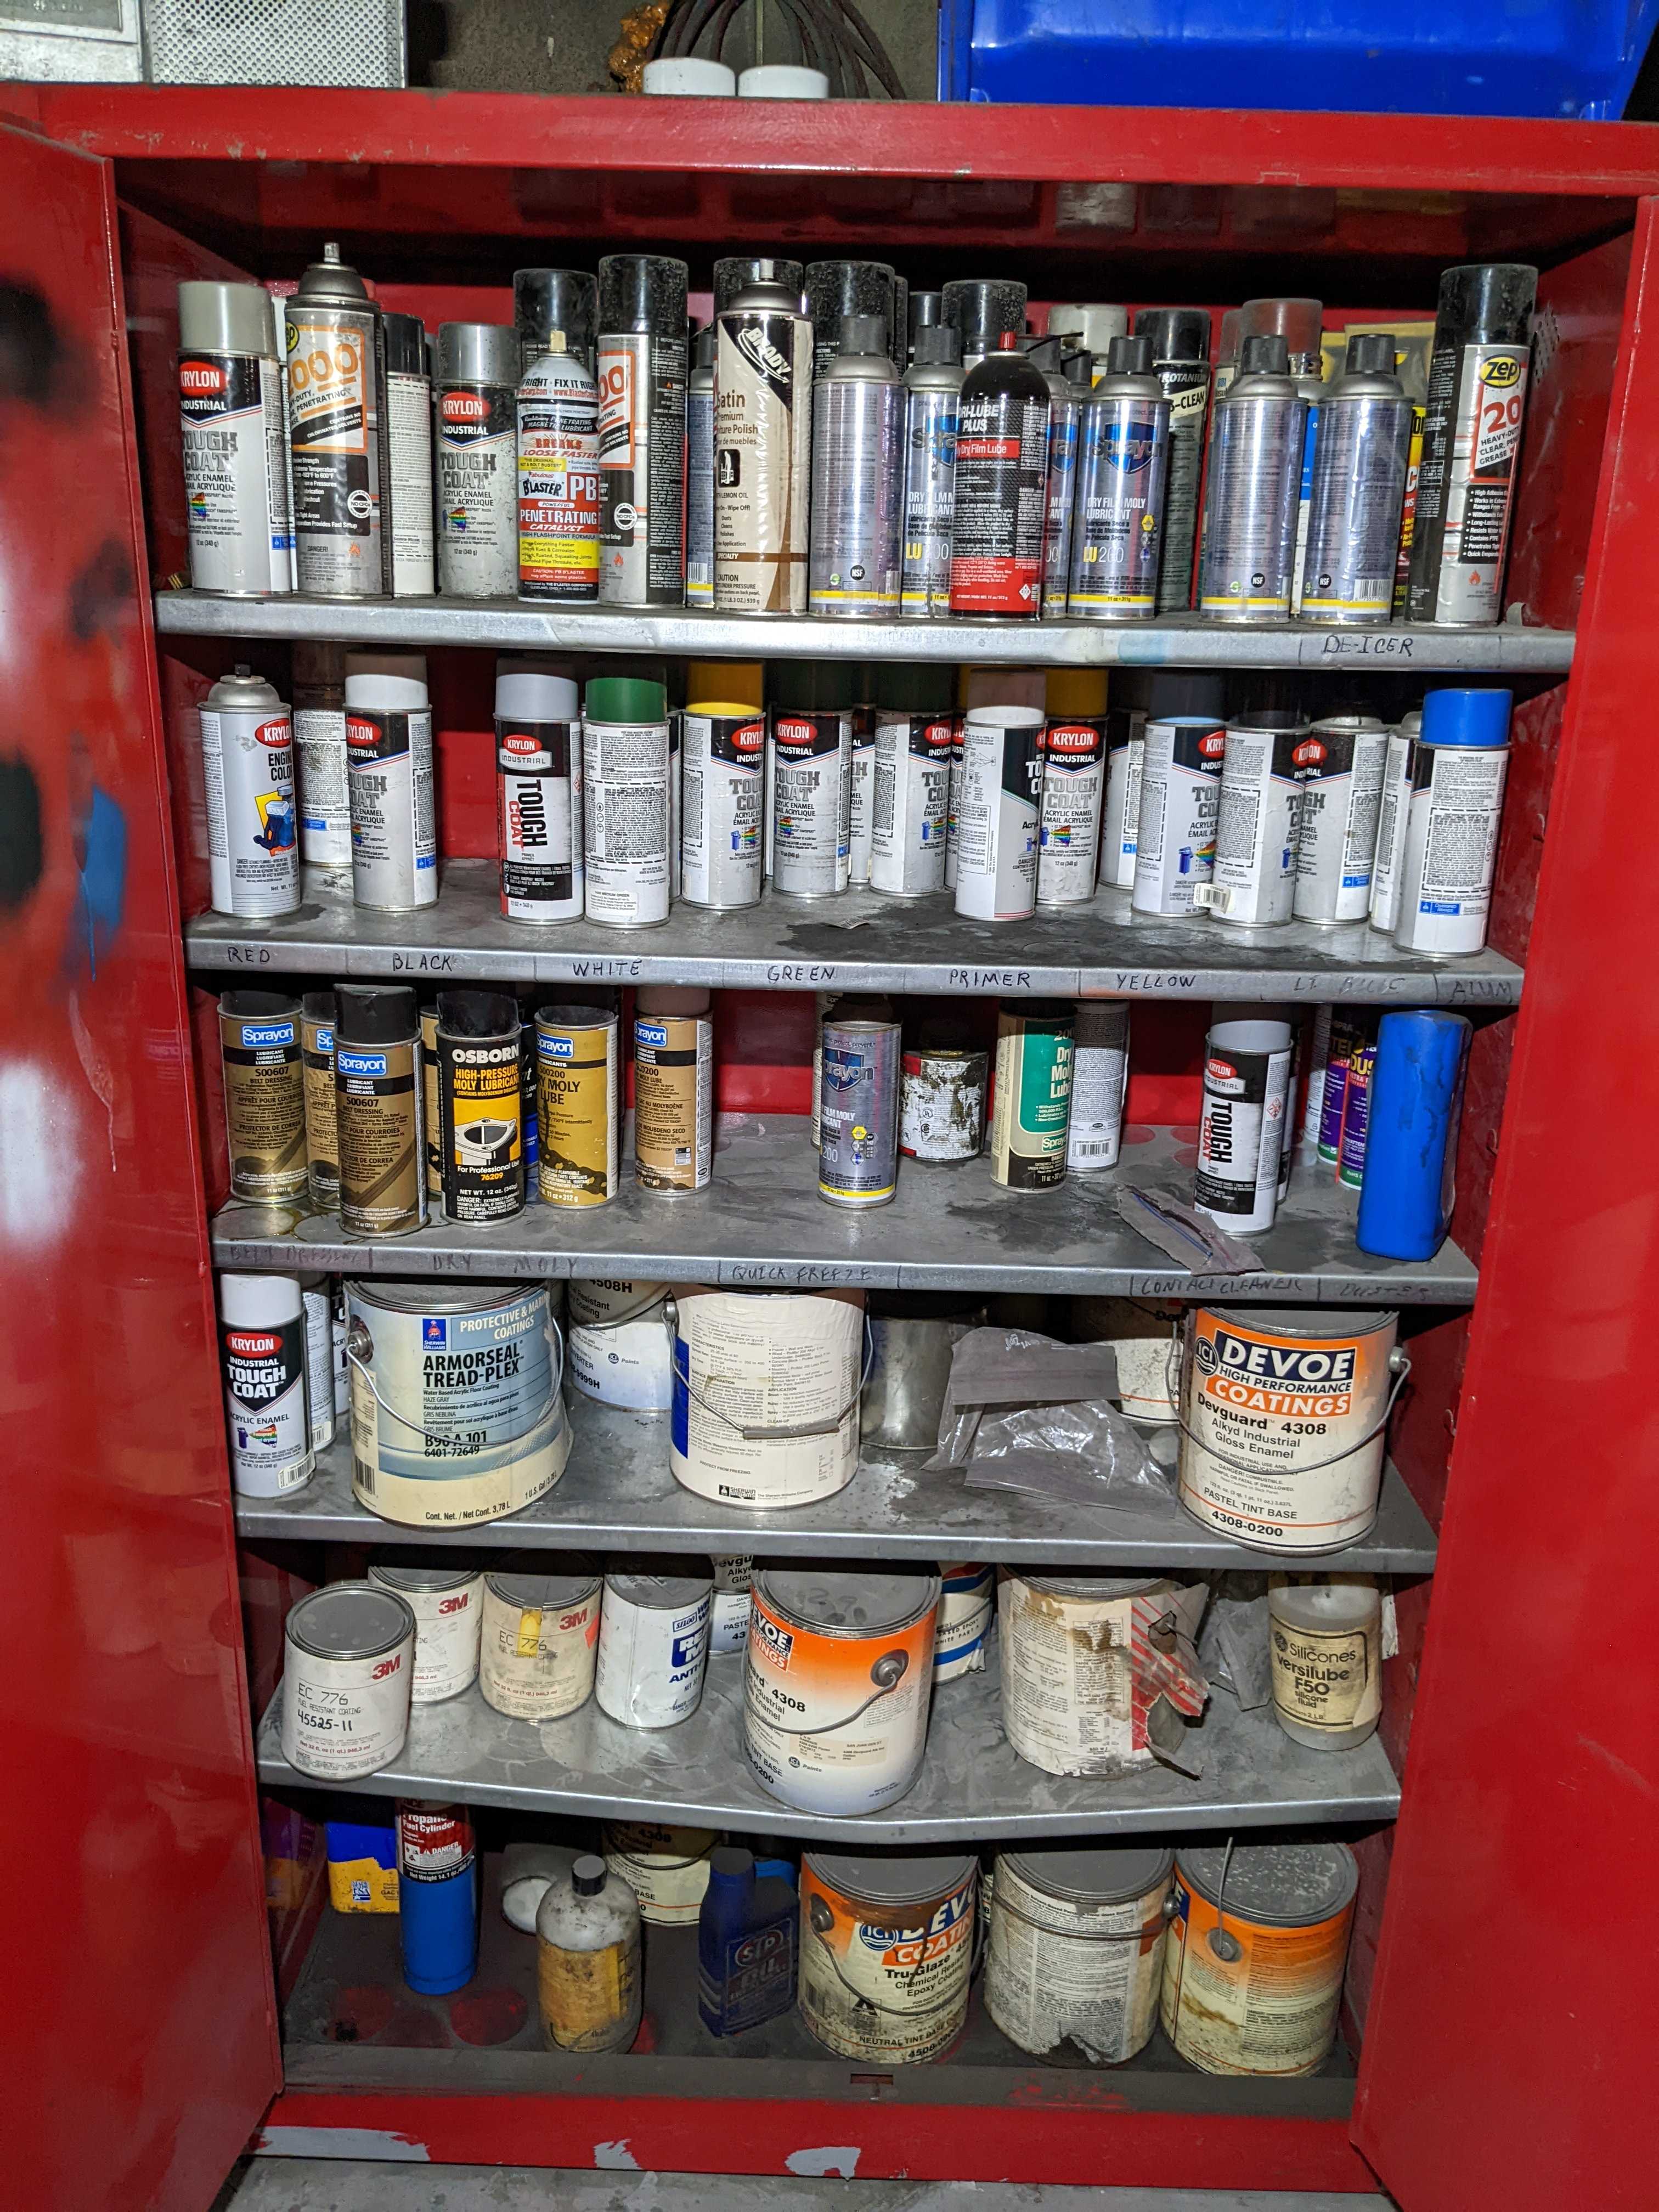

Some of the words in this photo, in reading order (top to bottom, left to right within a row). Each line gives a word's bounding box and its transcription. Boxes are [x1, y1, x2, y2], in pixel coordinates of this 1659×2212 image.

[555, 379, 571, 387] FIX
[443, 400, 483, 415] KRYLON
[733, 424, 758, 434] Polish
[963, 419, 988, 432] PLUS
[535, 438, 582, 450] BREAKS
[971, 444, 986, 454] Film
[988, 444, 1007, 454] Lube
[561, 450, 597, 459] FASTER
[203, 474, 233, 482] ENAMEL
[443, 471, 489, 489] COAT
[570, 475, 597, 501] PB
[908, 492, 924, 503] DRY
[1087, 497, 1102, 508] DRY
[1125, 498, 1146, 509] MOLY
[520, 509, 597, 524] PENETRATING
[1322, 633, 1415, 658] DE-ICER
[777, 723, 810, 739] KRYLON
[1053, 732, 1093, 746] KRYLON
[507, 739, 535, 751] KRYLON
[502, 754, 546, 764] INDUSTRIAL
[1049, 754, 1096, 763] INDUSTRIAL
[1043, 776, 1098, 793] TOUGH
[1047, 793, 1091, 809] COAT
[517, 779, 548, 848] TOUGH
[785, 808, 816, 817] ACRYLIQUE
[509, 800, 524, 849] COAT
[228, 946, 270, 964] RED
[393, 952, 453, 972] BLACK
[573, 960, 642, 977] WHITE
[767, 966, 835, 982] GREEN
[949, 968, 1030, 988] PRIMER
[1116, 974, 1197, 989] YELLOW
[244, 1026, 292, 1043] Sprayon
[452, 1044, 520, 1064] OSBORN
[338, 1054, 386, 1071] Sprayon
[1209, 1062, 1231, 1076] KRYLON
[255, 1066, 289, 1077] S00607
[265, 1075, 293, 1084] DRESSING
[455, 1063, 518, 1080] HIGH-PRESSURE
[454, 1079, 476, 1091] MOLY
[548, 1079, 581, 1093] MOLY
[346, 1096, 379, 1107] S00607
[354, 1107, 383, 1115] DRESSING
[838, 1110, 855, 1121] MOLY
[644, 1126, 672, 1134] MOLIBDENO
[1210, 1102, 1233, 1164] TOUGH
[469, 1163, 511, 1174] Professional
[481, 1172, 504, 1181] 76209
[732, 1266, 786, 1281] QUICK
[797, 1265, 872, 1283] FREEZE
[460, 1308, 520, 1333] PROTECTIVE
[521, 1307, 527, 1317] &
[494, 1316, 534, 1340] COATINGS
[231, 1336, 274, 1351] KRYLON
[423, 1342, 520, 1371] ARMORSEAL
[1198, 1344, 1214, 1363] ICI
[1221, 1338, 1352, 1380] DEVOE
[229, 1356, 279, 1368] INDUSTRIAL
[227, 1363, 286, 1384] TOUGH
[423, 1358, 520, 1387] TREAD-PLEX
[1220, 1365, 1250, 1385] HIGH
[1253, 1379, 1351, 1393] PERFORMANCE
[233, 1380, 279, 1398] COAT
[482, 1383, 500, 1393] Coating
[1215, 1379, 1349, 1415] COATINGS
[256, 1413, 290, 1425] ENAMEL
[1197, 1392, 1268, 1431] Devguard
[1281, 1422, 1327, 1435] 4308
[1210, 1418, 1240, 1438] Alkyd
[1244, 1429, 1301, 1448] Industrial
[425, 1445, 480, 1458] 6401-72649
[1215, 1431, 1246, 1451] Gloss
[1249, 1442, 1294, 1460] Enamel
[1217, 1464, 1245, 1477] DANGER!
[1204, 1487, 1238, 1509] PASTEL
[1239, 1501, 1265, 1515] TINT
[1267, 1509, 1298, 1520] BASE
[1211, 1510, 1284, 1537] 4308-0200
[438, 1593, 469, 1615] 3M
[558, 1609, 588, 1630] 3M
[498, 1630, 514, 1647] EC
[520, 1638, 548, 1652] 776
[1289, 1643, 1357, 1663] Silicones
[371, 1654, 402, 1681] 3M
[1294, 1675, 1330, 1696] F50
[297, 1682, 313, 1701] EC
[319, 1691, 349, 1706] 776
[772, 1689, 806, 1713] 4308
[1294, 1690, 1329, 1703] silicone
[1297, 1697, 1317, 1709] fluid
[338, 1707, 362, 1716] COATING
[403, 1819, 419, 1831] Fuel
[419, 1820, 456, 1834] Cylinder
[431, 1841, 459, 1855] DANGER
[884, 1953, 952, 1979] Tru-Glaze
[895, 1972, 939, 1989] Chemical
[906, 1981, 935, 1997] Epoxy
[859, 2035, 904, 2047] NEUTRAL
